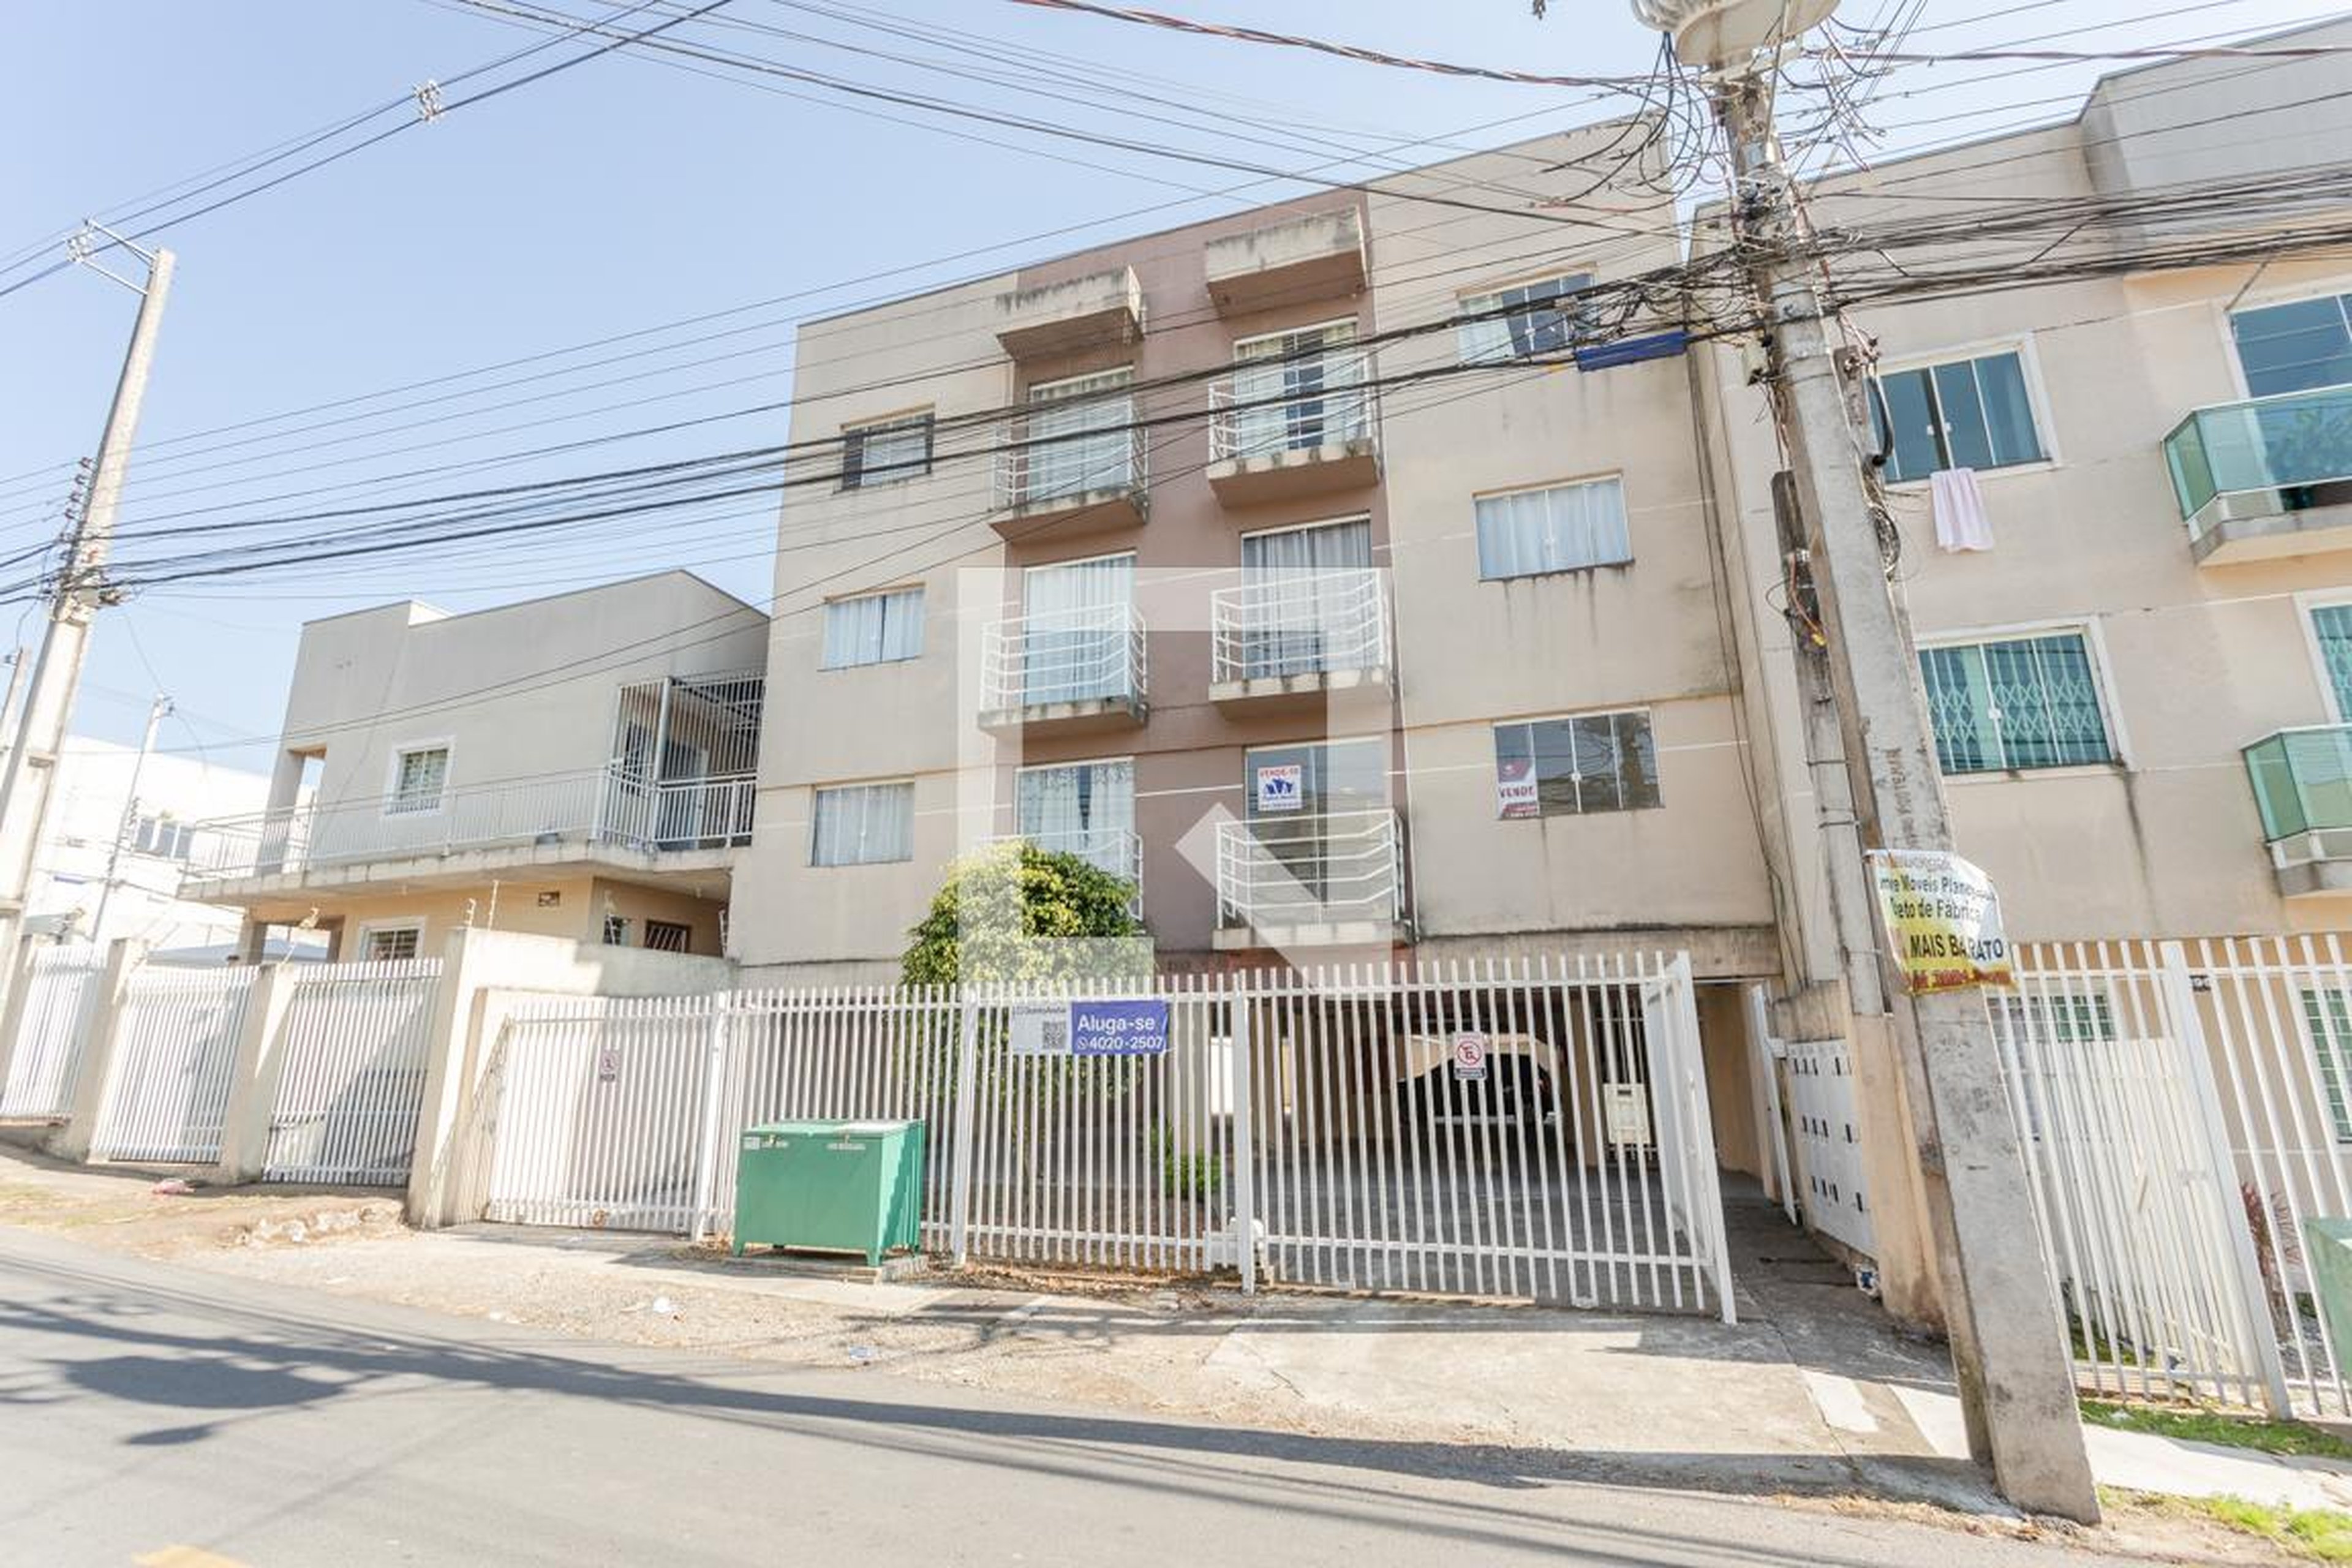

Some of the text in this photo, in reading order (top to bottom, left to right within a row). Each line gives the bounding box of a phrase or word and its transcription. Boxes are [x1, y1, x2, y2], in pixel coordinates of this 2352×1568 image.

[1910, 934, 1945, 958] MAIS
[1077, 1015, 1155, 1035] Aluga-se
[1090, 1036, 1163, 1050] 4020-2507
